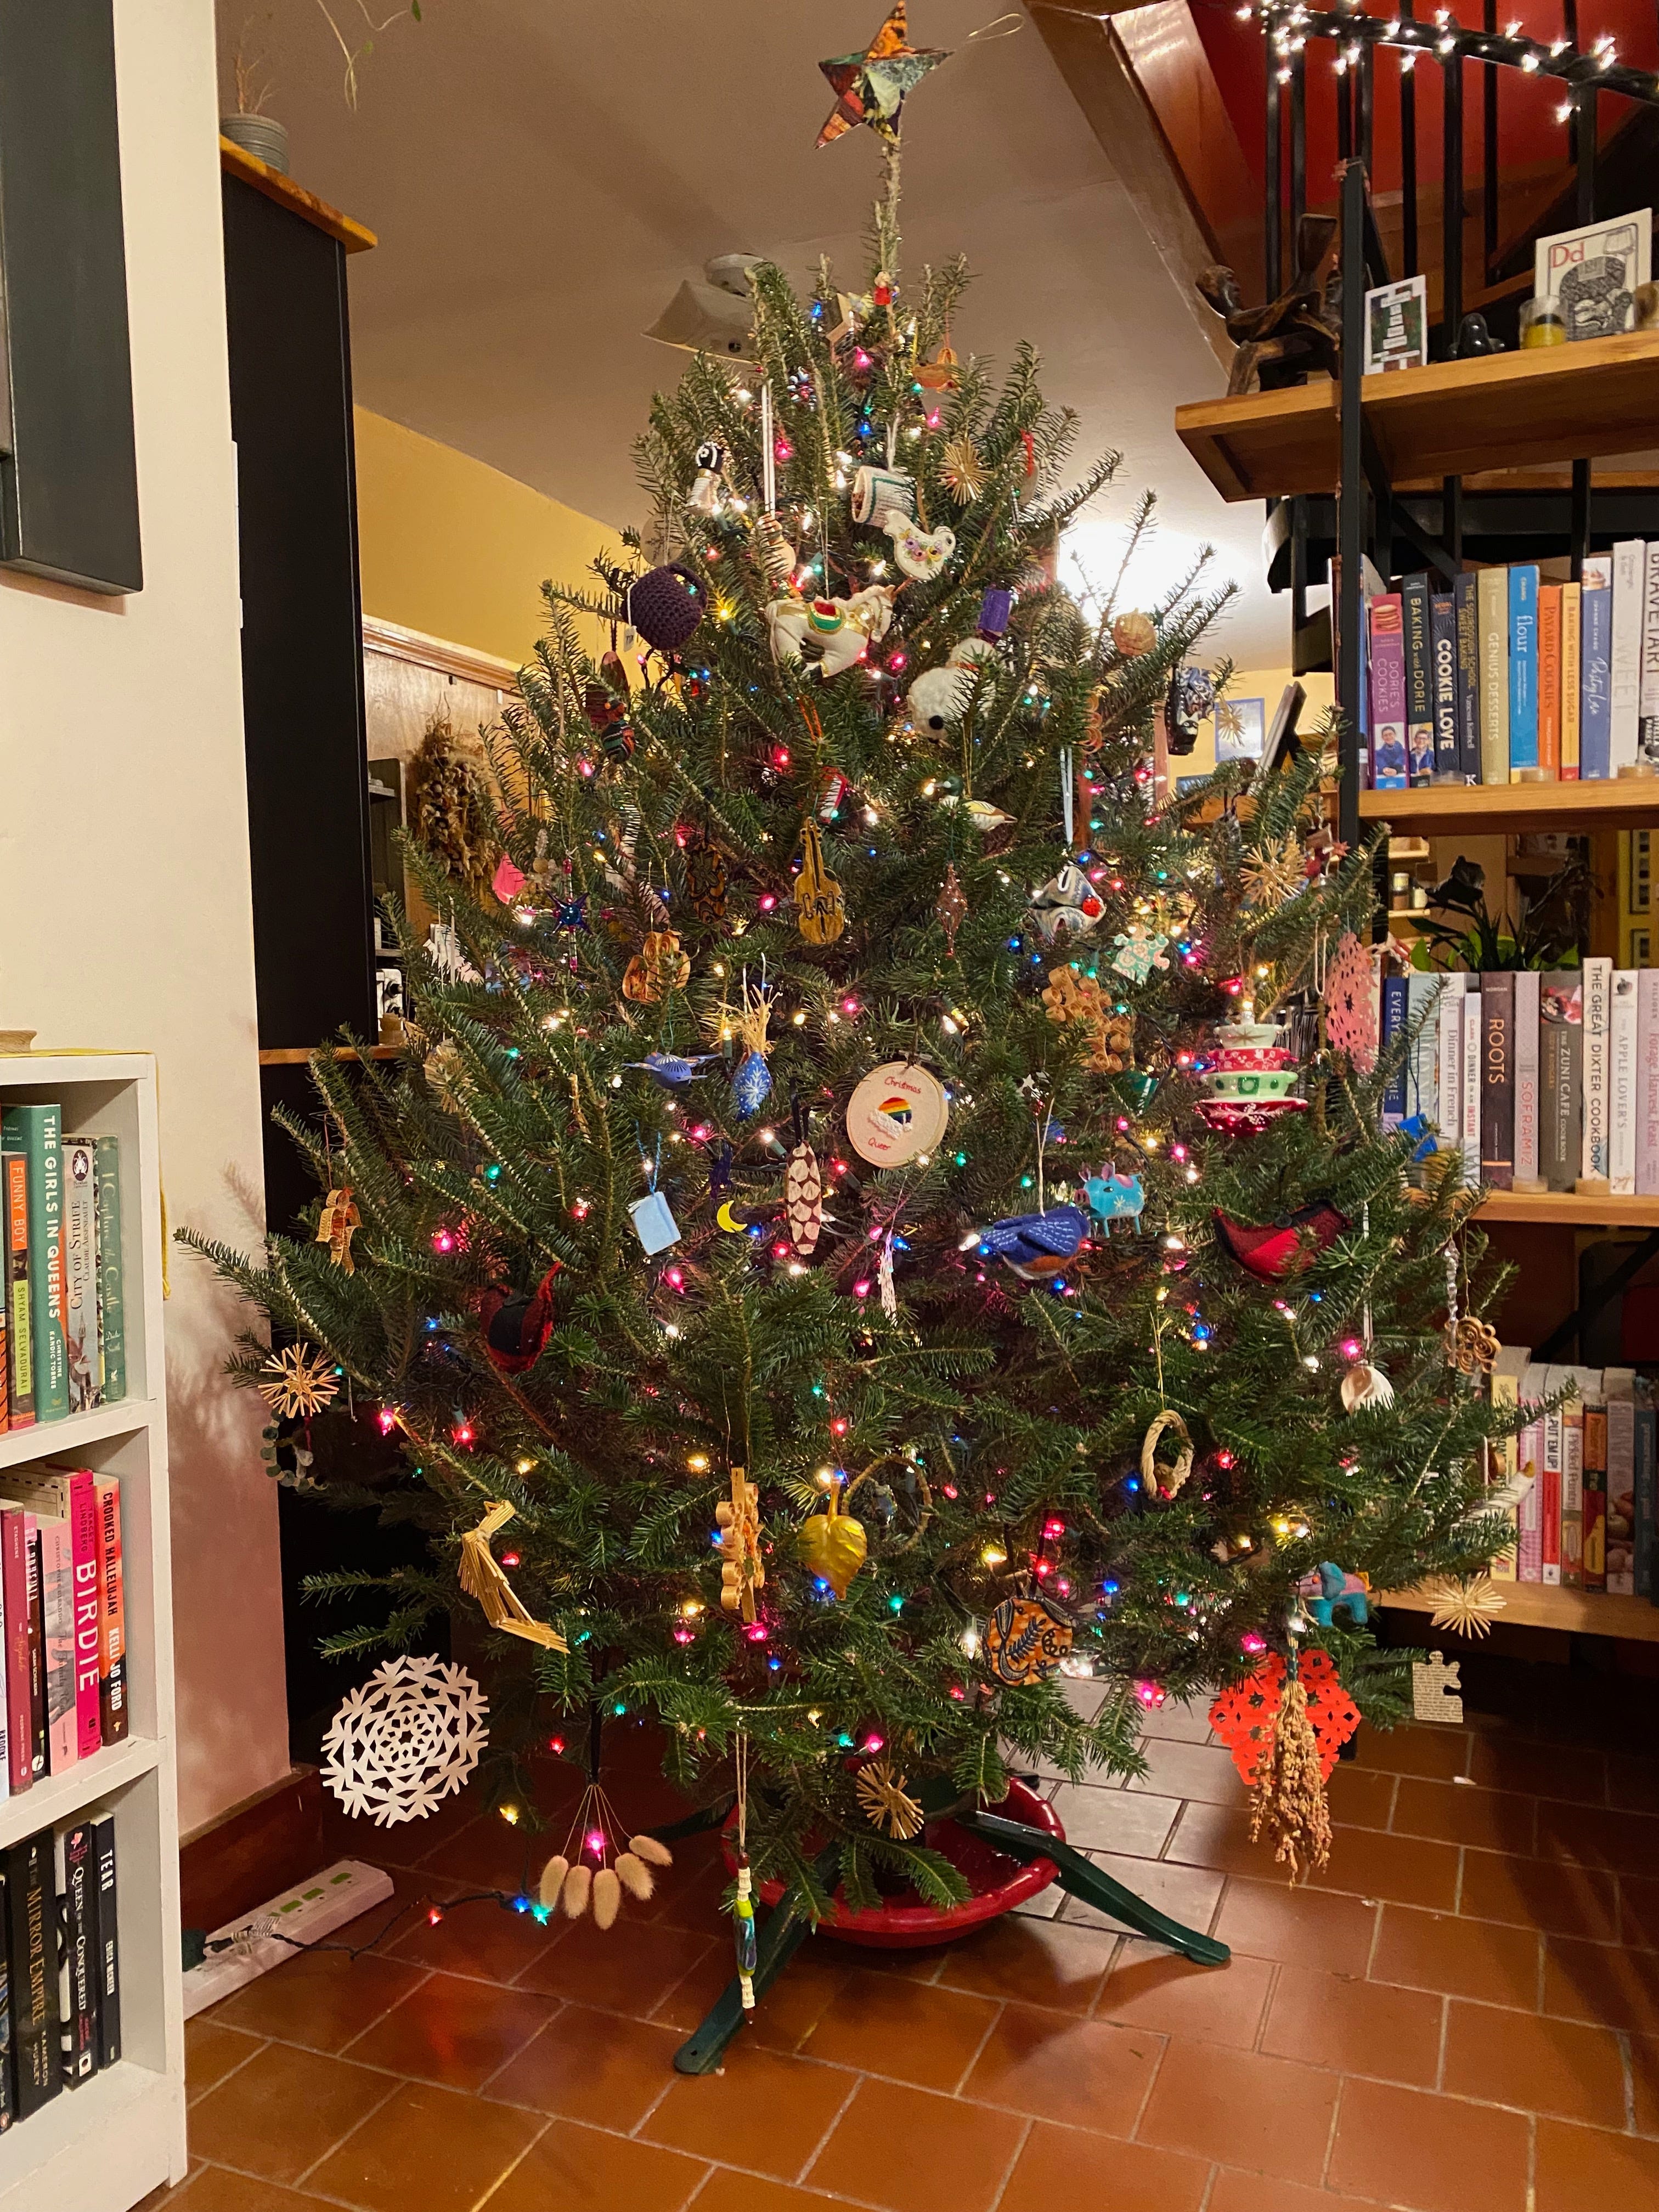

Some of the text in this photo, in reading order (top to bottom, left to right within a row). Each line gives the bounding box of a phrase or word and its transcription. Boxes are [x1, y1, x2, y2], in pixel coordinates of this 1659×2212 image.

[1551, 241, 1586, 268] Dd
[1465, 584, 1474, 601] THE
[1410, 597, 1423, 651] BAKING
[1516, 614, 1533, 653] flour
[1544, 606, 1557, 708] PAYARD COOKIES
[1377, 658, 1389, 713] COOKIES
[1389, 661, 1400, 708] DORIE'S
[1413, 670, 1425, 712] DORIE
[1437, 639, 1454, 751] COOKIE LOVE
[1488, 632, 1499, 741] GENIUS DESSERTS
[1468, 1054, 1476, 1082] DINNER
[1488, 1018, 1505, 1084] ROOTS
[1560, 1048, 1571, 1080] ZUNI
[1590, 965, 1602, 1172] THE GREAT DIXTER COOKBOOK
[1618, 1034, 1629, 1073] APPLE
[884, 1076, 922, 1094] Christmas
[1447, 1029, 1458, 1126] Dinner in French
[1618, 1077, 1628, 1128] LOVER'S
[1467, 1105, 1476, 1137] INSTANT
[1521, 1081, 1533, 1165] SOFRAMIZ
[12, 1167, 25, 1243] FUNNY BOY
[44, 1115, 60, 1319] THE GIRLS IN QUEENS
[70, 1200, 81, 1250] STRIFE
[73, 1254, 82, 1271] OF
[70, 1276, 82, 1310] CITY
[18, 1287, 27, 1388] SHYAM SELVADURAI
[1548, 1418, 1559, 1435] PUT
[79, 1502, 88, 1552] LINDBERG
[103, 1492, 118, 1616] CROOKED HALLELUJAH
[76, 1559, 99, 1692] BIRDIE
[108, 1626, 122, 1711] KELLI JO FORD
[72, 1866, 84, 1911] QUEEN
[100, 1848, 114, 1891] TEAR
[27, 1886, 43, 1960] MIRROR
[30, 1956, 46, 2027] EMPIRE
[76, 1936, 86, 2010] CONQUERED
